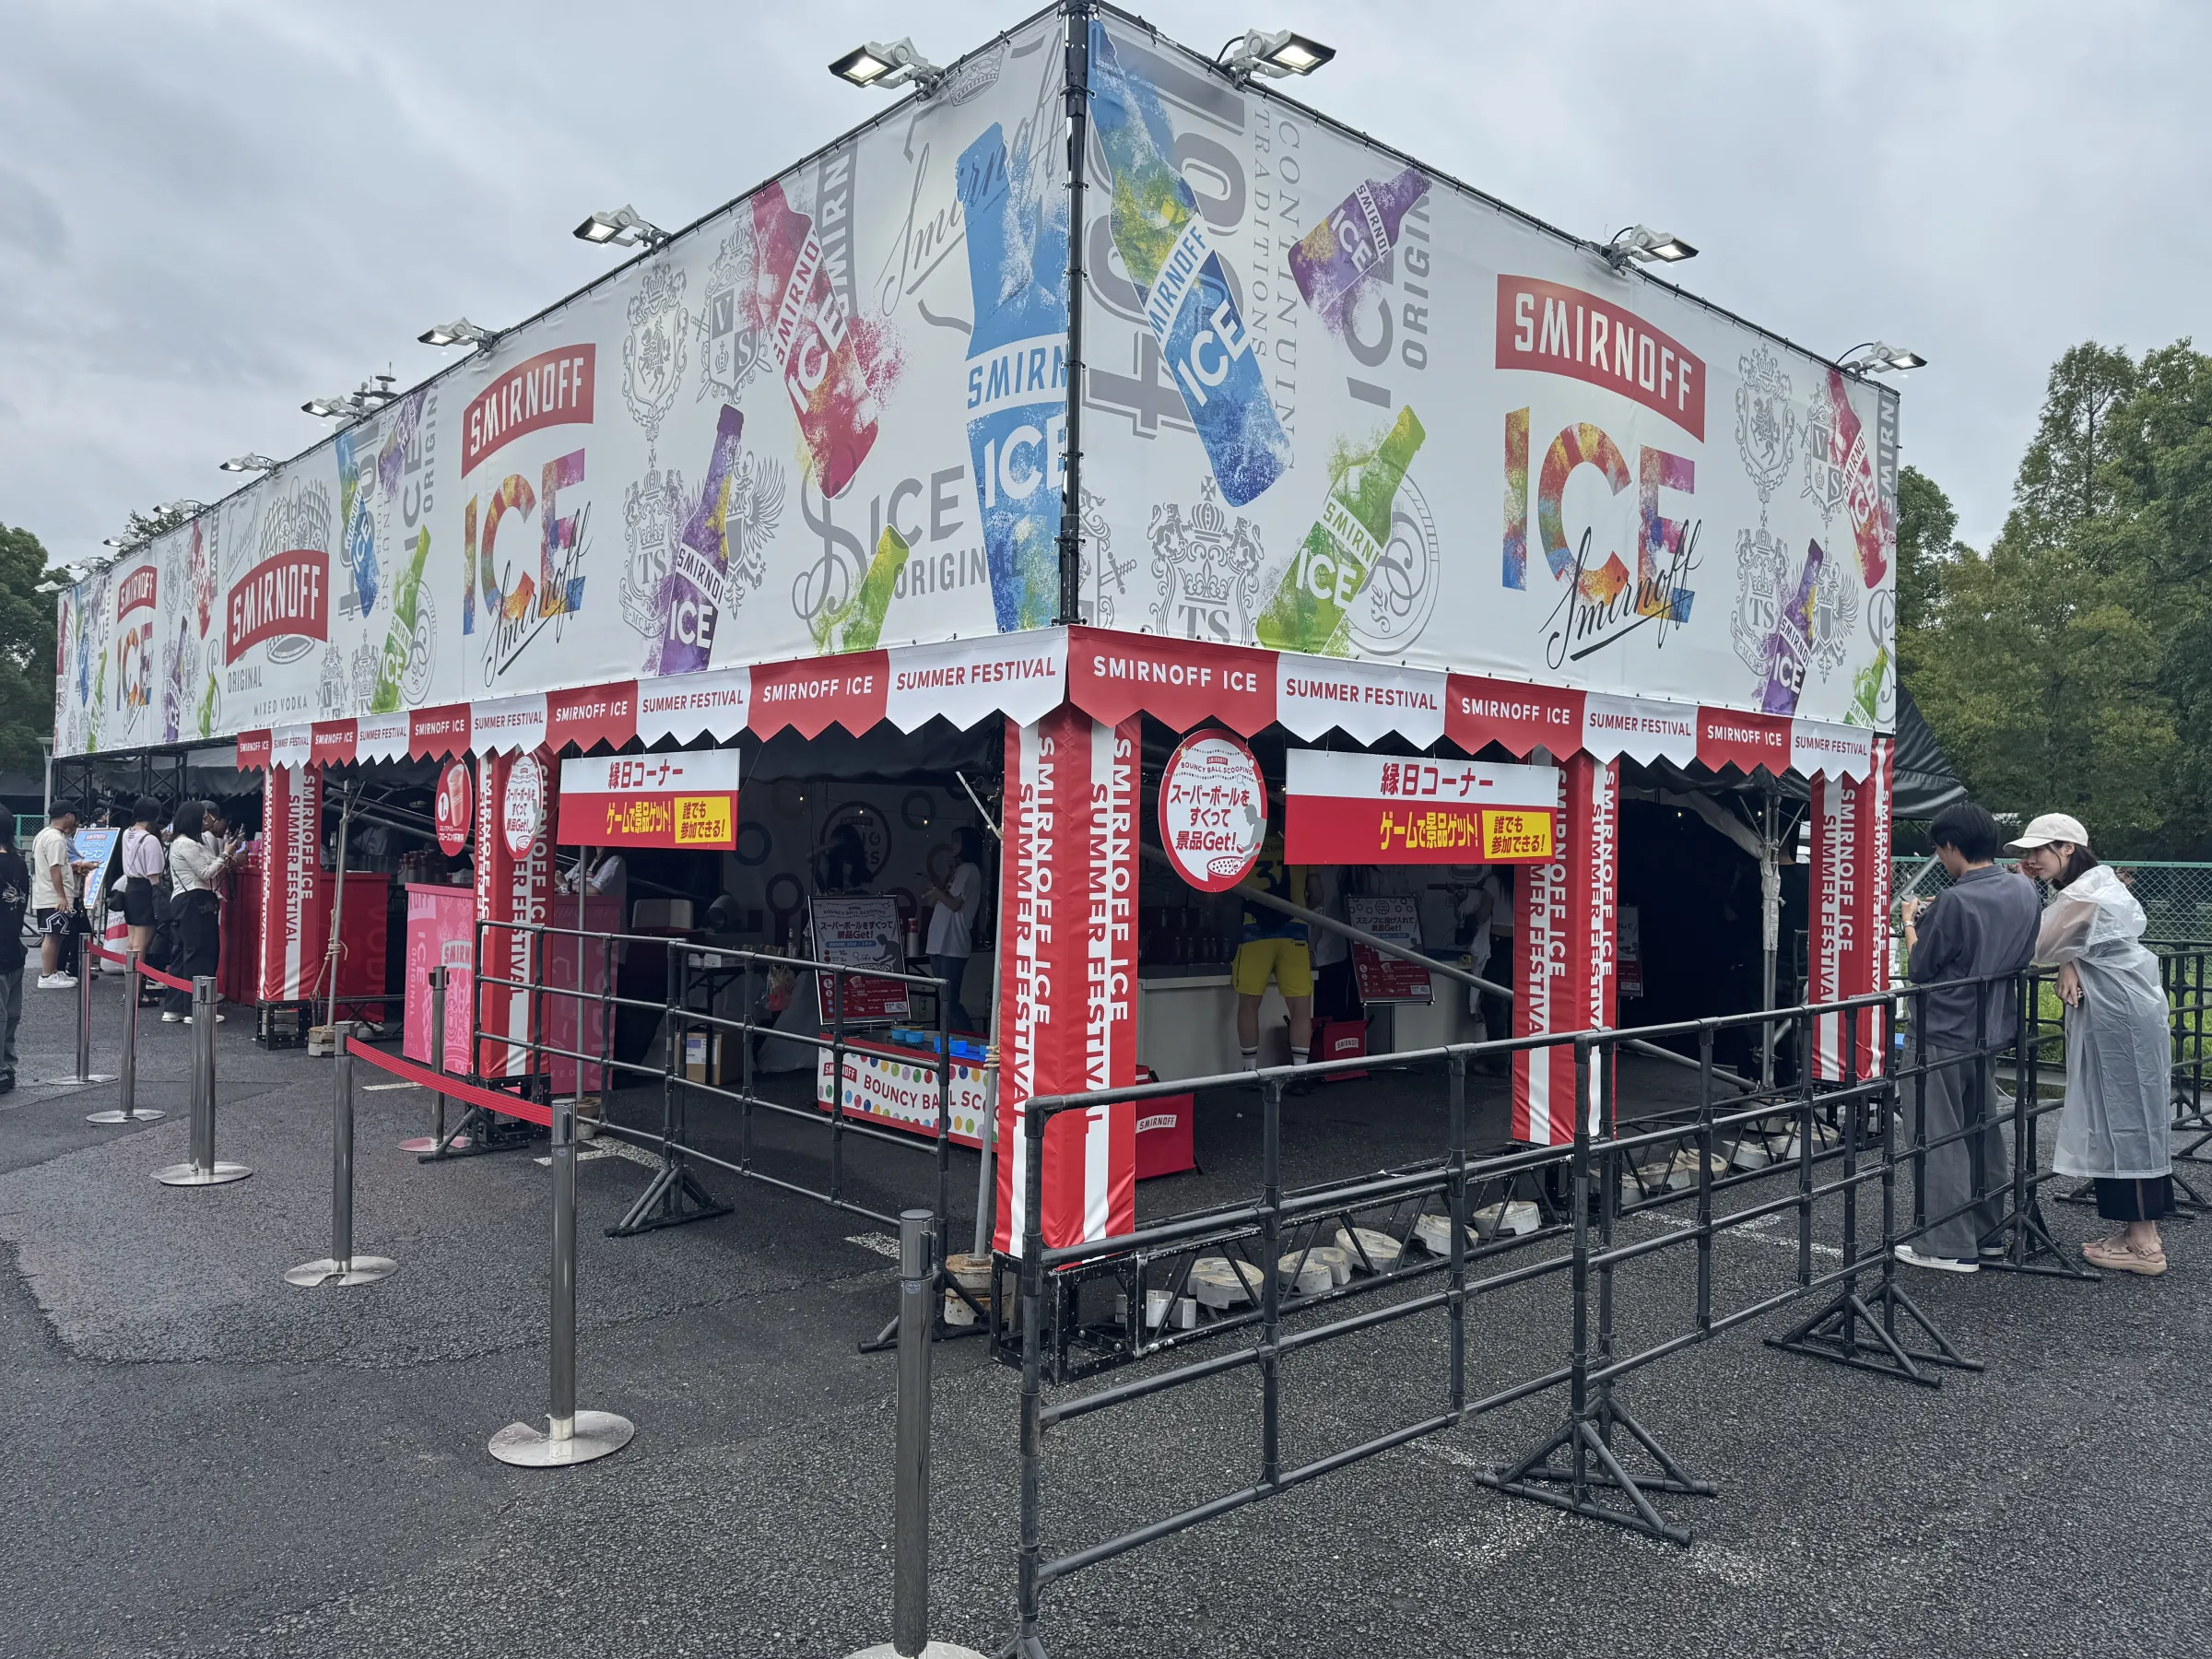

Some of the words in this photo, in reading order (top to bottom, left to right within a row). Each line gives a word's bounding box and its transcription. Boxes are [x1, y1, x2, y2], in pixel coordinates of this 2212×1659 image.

[1249, 110, 1270, 358] TRADITIONS
[1330, 208, 1371, 273] ICE
[772, 227, 819, 366] SMIRNO
[1178, 304, 1251, 406] ICE
[1514, 292, 1692, 412] SMIRNOFF
[470, 358, 584, 457] SMIRNOFF
[394, 416, 408, 453] ICE
[870, 465, 965, 555] ICE
[1323, 501, 1380, 566] SMIRN
[1501, 406, 1696, 624] ICE
[1850, 481, 1877, 534] ICE
[354, 520, 370, 572] ICE
[463, 448, 586, 636] ICE
[119, 571, 155, 614] SMIRNOFF
[232, 563, 321, 646] SMIRNOFF
[480, 501, 594, 688] Smirnoff
[1295, 547, 1359, 610] ICE
[1538, 519, 1703, 670] Smirnoff
[668, 600, 713, 650] ICE
[227, 665, 263, 693] ORIGINAL
[381, 652, 404, 685] ICE
[762, 678, 840, 703] SMIRNOFF
[845, 675, 873, 696] ICE
[896, 665, 966, 691] SUMMER
[971, 656, 1056, 684] FESTIVAL
[1093, 655, 1212, 688] SMIRNOFF
[1223, 673, 1257, 693] ICE
[1286, 677, 1359, 703] SUMMER
[1364, 687, 1438, 712] FESTIVAL
[1773, 654, 1803, 694] ICE
[253, 700, 277, 717] MIXED
[280, 694, 308, 712] VODKA
[475, 715, 505, 730] SUMMER
[507, 711, 544, 726] FESTIVAL
[556, 701, 606, 723] SMIRNOFF
[610, 700, 628, 716] ICE
[642, 693, 688, 713] SUMMER
[689, 689, 744, 710] FESTIVAL
[1462, 697, 1539, 723] SMIRNOFF
[1547, 706, 1571, 724] ICE
[1589, 712, 1638, 732] SUMMER
[1641, 718, 1691, 736] FESTIVAL
[315, 733, 342, 746] SMIRNOFF
[343, 731, 353, 743] ICE
[359, 729, 381, 742] SUMMER
[382, 725, 407, 738] FESTIVAL
[415, 721, 449, 736] SMIRNOFF
[452, 719, 465, 732] ICE
[1707, 724, 1761, 745] SMIRNOFF
[1765, 733, 1783, 747] ICE
[1794, 735, 1830, 752] SUMMER
[1831, 741, 1867, 757] FESTIVAL
[608, 759, 683, 790] 縁日コーナー
[1181, 761, 1206, 773] BOUNCY
[1223, 766, 1253, 775] SCOOPING
[1380, 762, 1494, 797] 縁日コーナー
[301, 775, 315, 865] SMIRNOFF
[683, 801, 706, 819] 誰でも
[1170, 784, 1250, 807] スーパーボールを
[1190, 806, 1231, 828] すくって
[288, 794, 300, 864] SUMMER
[1034, 737, 1054, 944] SMIRNOFF
[1111, 738, 1132, 941] SMIRNOFF
[1493, 816, 1524, 834] 誰でも
[1602, 771, 1615, 919] SMIRNOFF
[1840, 789, 1856, 906] SMIRNOFF
[1880, 790, 1889, 910] SMIRNOFF
[301, 871, 313, 900] ICE
[1017, 783, 1034, 942] SUMMER
[1088, 783, 1108, 943] SUMMER
[1591, 804, 1603, 916] SUMMER
[1822, 815, 1838, 905] SUMMER
[1873, 816, 1881, 907] SUMMER
[286, 869, 300, 947] FESTIVAL
[820, 921, 893, 931] スーパーボールをすくって
[1838, 915, 1853, 951] ICE
[1879, 915, 1888, 951] ICE
[417, 932, 427, 986] ICE
[1549, 931, 1566, 977] ICE
[1590, 927, 1602, 1029] FESTIV
[1601, 931, 1613, 976] ICE
[1819, 912, 1835, 1005] FESTIVA
[1033, 962, 1051, 1024] ICE
[1109, 959, 1128, 1021] ICE
[1527, 924, 1546, 1037] FESTIVA
[1012, 955, 1030, 1128] FESTIVAL
[1085, 956, 1106, 1135] FESTIVL
[864, 1074, 918, 1109] BOUNCY
[923, 1093, 956, 1111] BAL
[1139, 1115, 1175, 1130] SMIRNOFF
